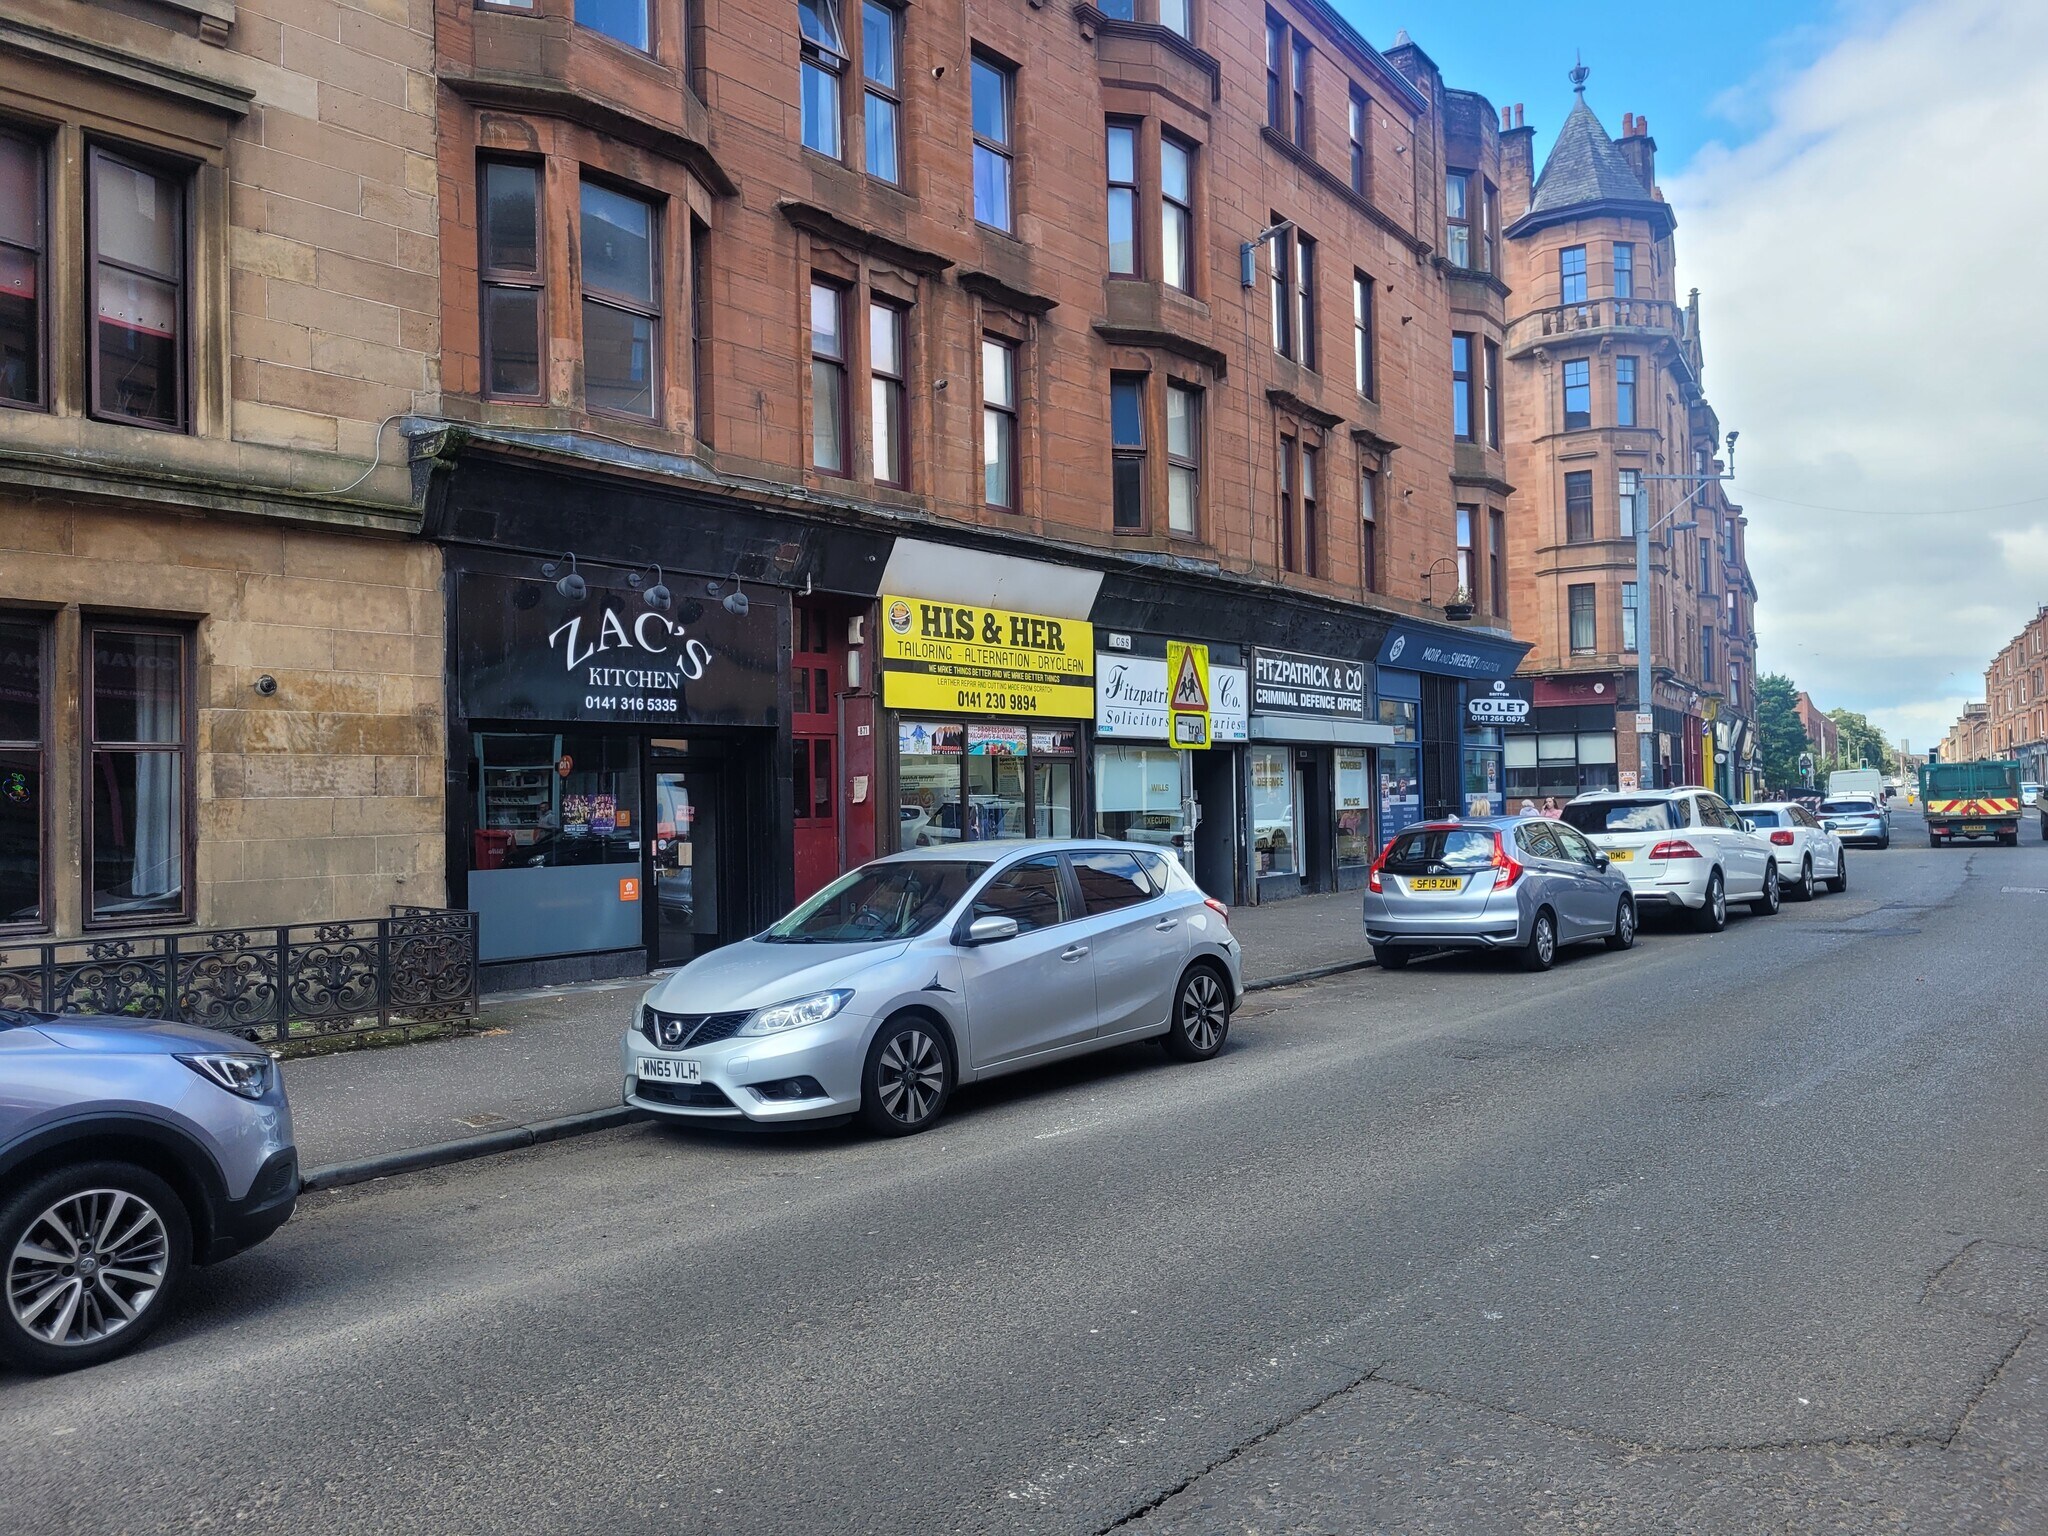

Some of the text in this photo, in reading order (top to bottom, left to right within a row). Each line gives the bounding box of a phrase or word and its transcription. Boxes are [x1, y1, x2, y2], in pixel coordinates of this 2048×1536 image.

[920, 604, 975, 641] HIS
[982, 612, 1003, 644] &
[1009, 616, 1065, 651] HER
[548, 607, 713, 680] ZAC'S
[1116, 637, 1130, 647] CSS
[897, 640, 952, 660] TAILORING
[964, 647, 1030, 668] ALTERNATION
[1038, 655, 1084, 673] DRYCLEAN
[1421, 647, 1442, 662] MOIR
[1440, 654, 1450, 664] AND
[1449, 652, 1481, 669] SWEENEY
[588, 667, 681, 690] KITCHEN
[929, 664, 1060, 683] WE MAKE THINGS BETTER AND WE MAKE BETTER THINGS
[1256, 657, 1362, 691] FITZPATRICK & CO
[937, 678, 960, 686] LEATHER
[1007, 683, 1020, 691] MADE
[1020, 684, 1033, 692] FROM
[1033, 685, 1053, 693] SCRATCH
[1105, 664, 1169, 706] Fitzpatri
[585, 695, 677, 712] 0141 316 5335
[957, 690, 1036, 711] 0141 230 9894
[1256, 689, 1362, 712] CRIMINAL DEFENCE OFFICE
[1472, 702, 1525, 713] TO LET
[1105, 710, 1169, 728] Solicitors
[1188, 723, 1202, 734] trol
[1151, 784, 1169, 792] WILLS
[1343, 798, 1360, 807] POLICE
[1143, 816, 1175, 825] EXECUTR
[1610, 851, 1626, 860] DMG
[1417, 879, 1458, 889] SF19 ZUM
[643, 1059, 697, 1079] WN65 VLH
